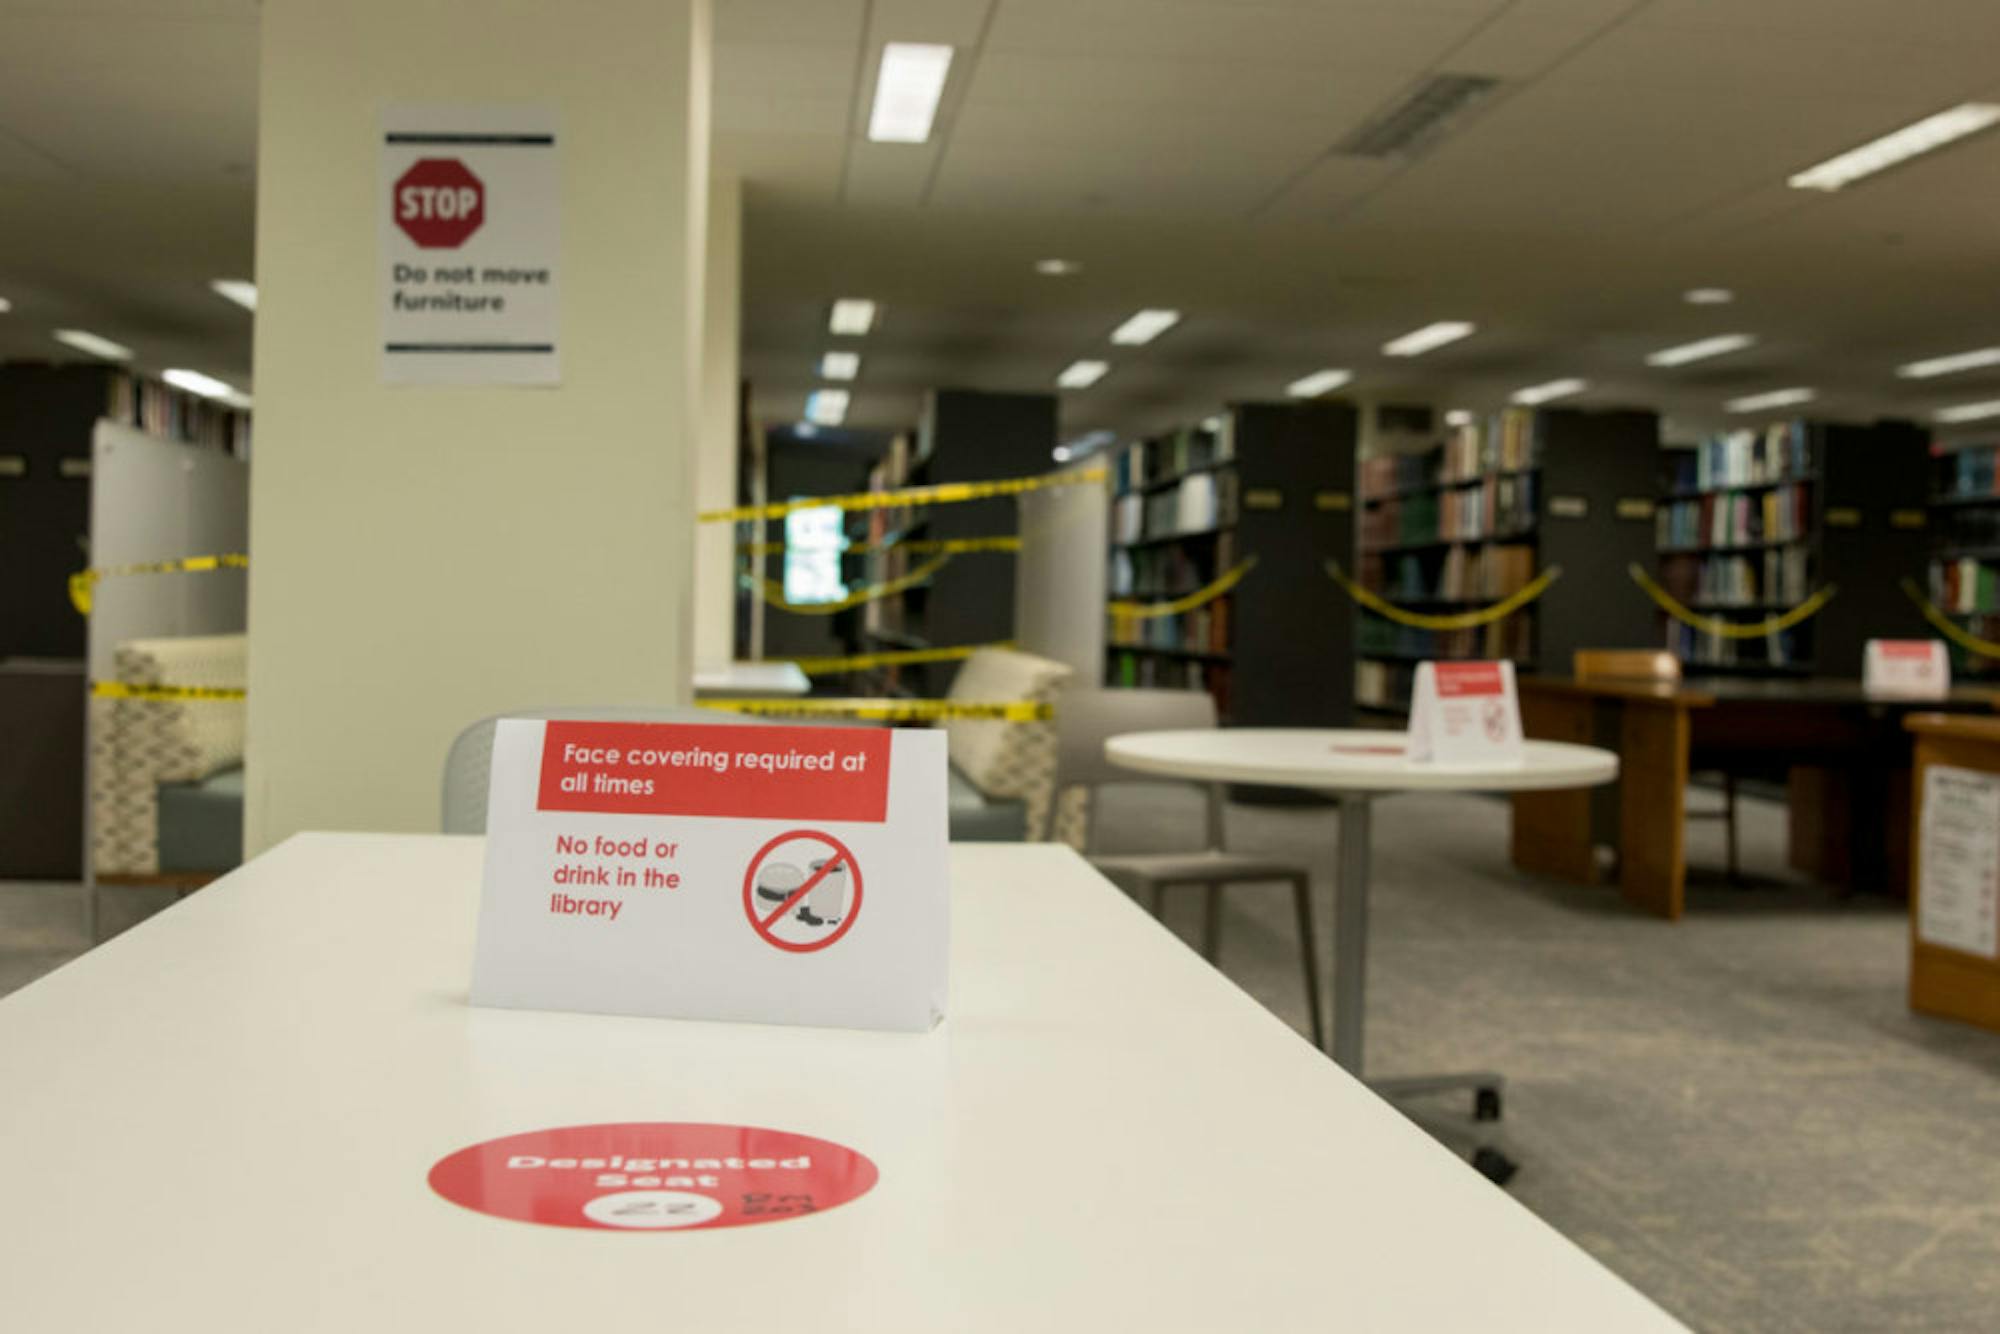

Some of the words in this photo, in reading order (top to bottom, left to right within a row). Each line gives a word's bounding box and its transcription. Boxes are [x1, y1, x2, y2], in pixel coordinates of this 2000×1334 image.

[401, 186, 478, 221] STOP
[394, 265, 427, 284] Do
[434, 267, 474, 284] not
[483, 269, 550, 284] move
[394, 290, 505, 313] furniture
[563, 744, 621, 765] Face
[627, 746, 729, 773] covering
[735, 749, 834, 774] required
[841, 751, 866, 772] at
[560, 773, 587, 793] all
[593, 774, 655, 795] times
[556, 834, 588, 855] No
[594, 835, 648, 858] food
[655, 842, 678, 859] or
[553, 864, 609, 886] drink
[616, 866, 636, 886] in
[643, 868, 681, 889] the
[550, 893, 622, 921] library
[507, 1156, 811, 1172] Designated
[596, 1174, 719, 1187] Seat
[611, 1201, 696, 1216] 22
